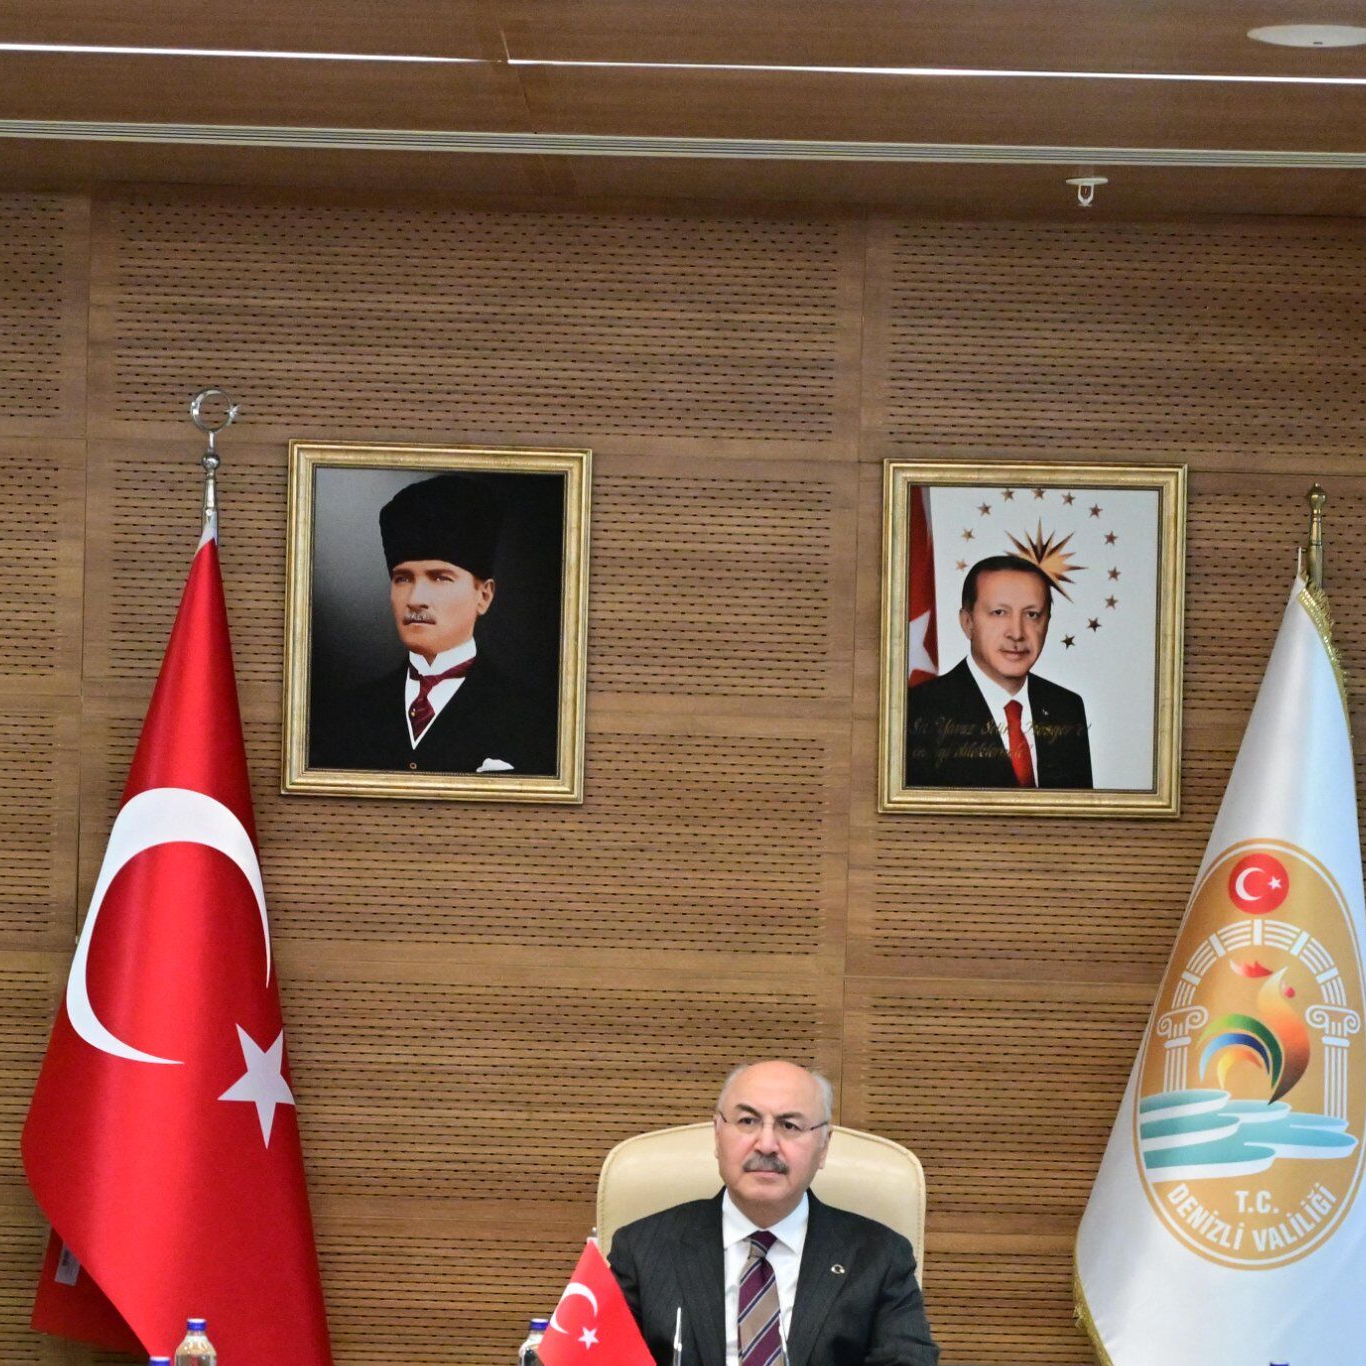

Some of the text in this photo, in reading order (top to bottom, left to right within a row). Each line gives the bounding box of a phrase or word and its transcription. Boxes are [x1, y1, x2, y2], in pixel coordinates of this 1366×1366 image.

[1167, 1182, 1337, 1252] DENİZLİ VALİLİĞİ
[1235, 1190, 1279, 1214] T.C.
